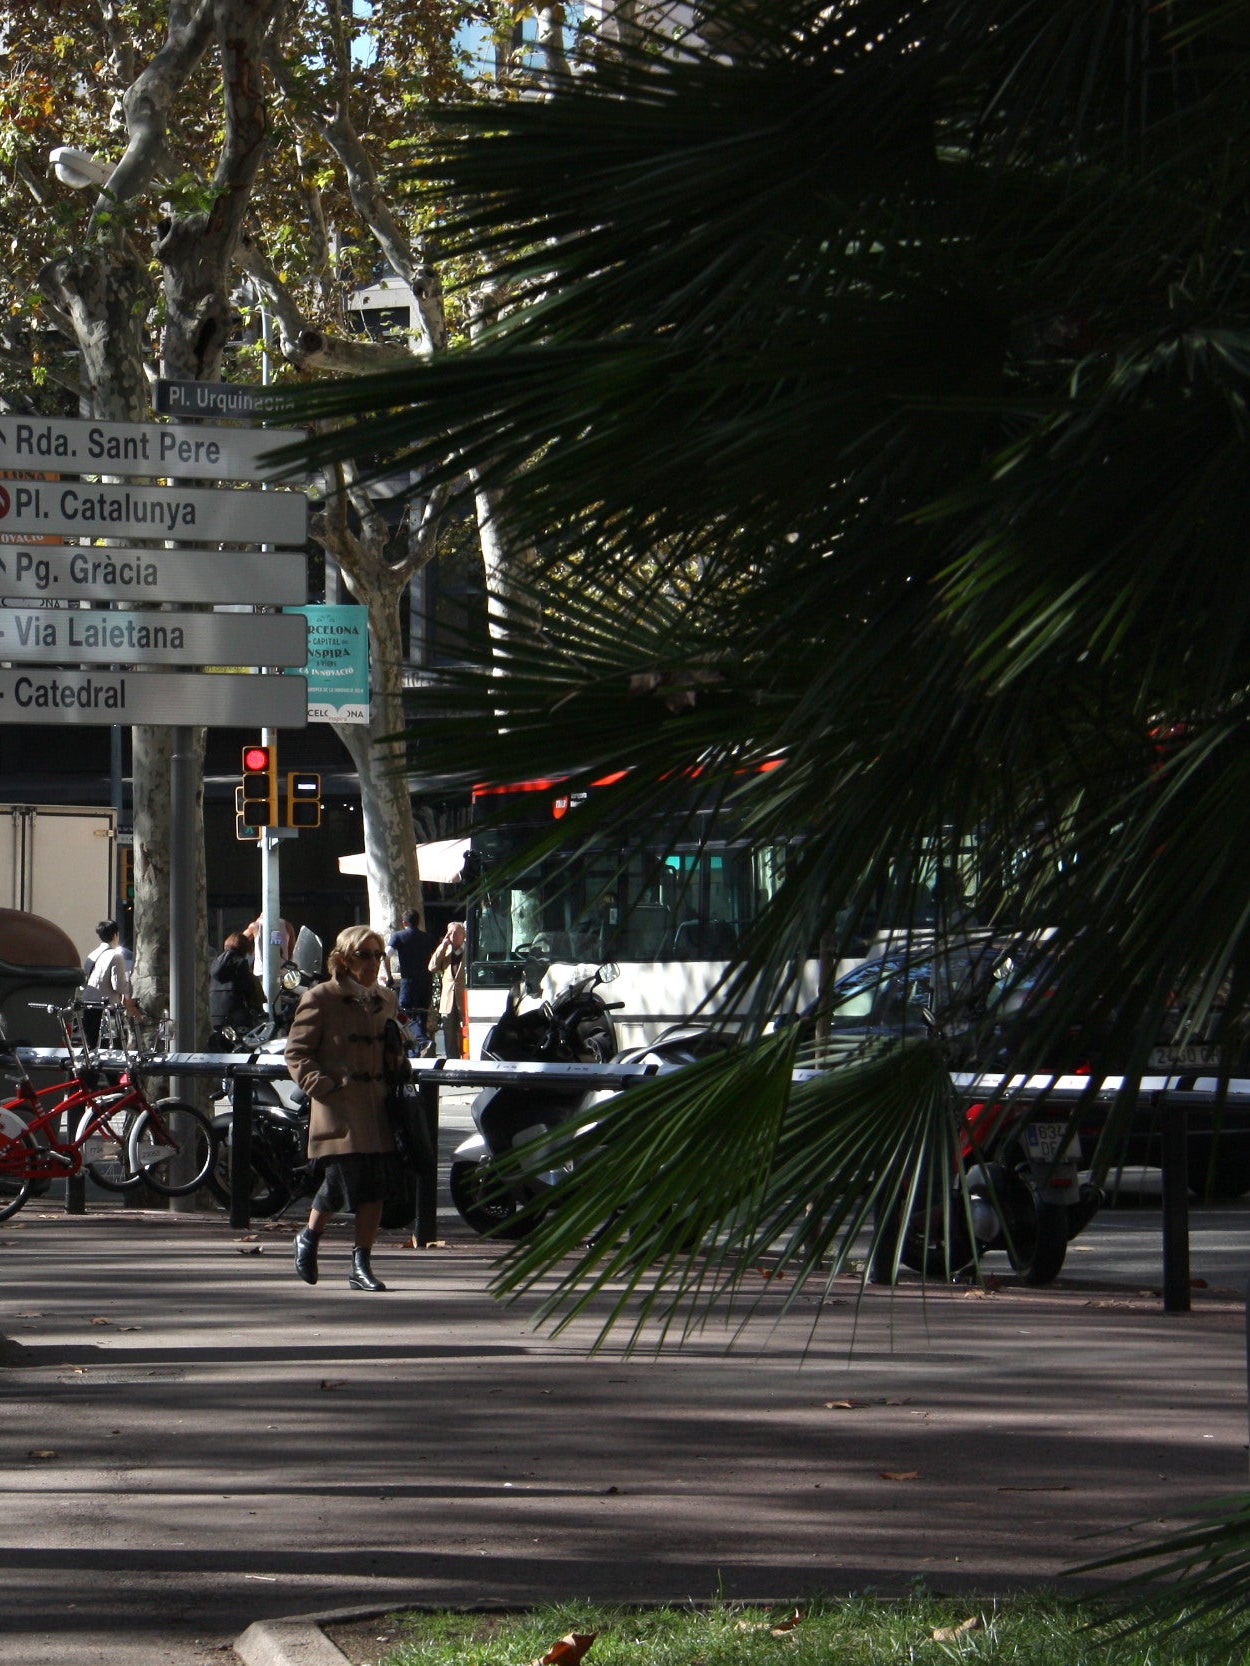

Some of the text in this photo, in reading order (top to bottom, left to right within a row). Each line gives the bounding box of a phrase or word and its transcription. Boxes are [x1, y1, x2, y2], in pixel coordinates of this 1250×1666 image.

[169, 386, 190, 406] Pl.
[16, 424, 221, 464] Rda. Sant Pere
[16, 488, 196, 531] Pl. Catalunya
[16, 551, 158, 590] Pg. Gràcia
[15, 615, 184, 650] Via Laietana
[308, 625, 359, 635] RCELONA
[307, 648, 351, 659] NSPIRA
[15, 676, 126, 709] Catedral
